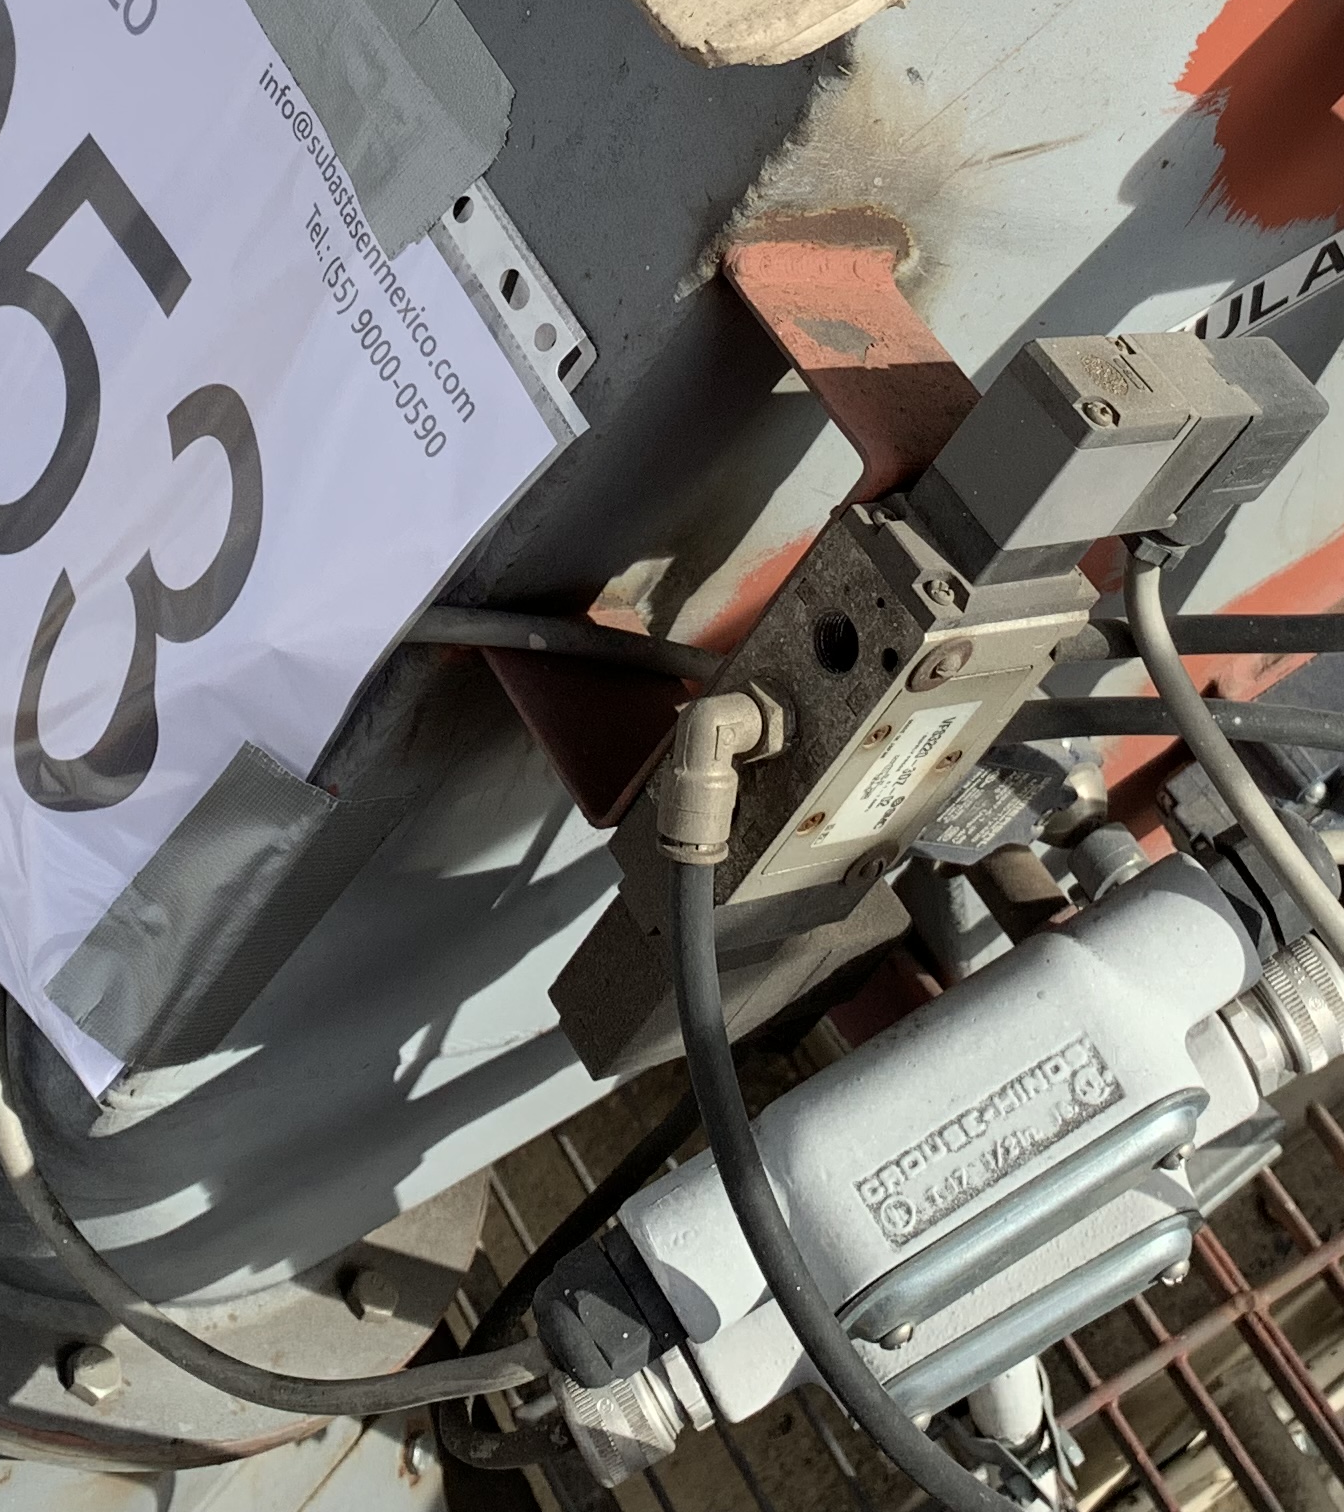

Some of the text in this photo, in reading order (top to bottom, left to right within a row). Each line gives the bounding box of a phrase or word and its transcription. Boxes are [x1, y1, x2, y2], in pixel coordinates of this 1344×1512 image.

[258, 62, 476, 424] info@subastasenmexico.com
[304, 202, 448, 458] Tel.: (55) 9000-0590
